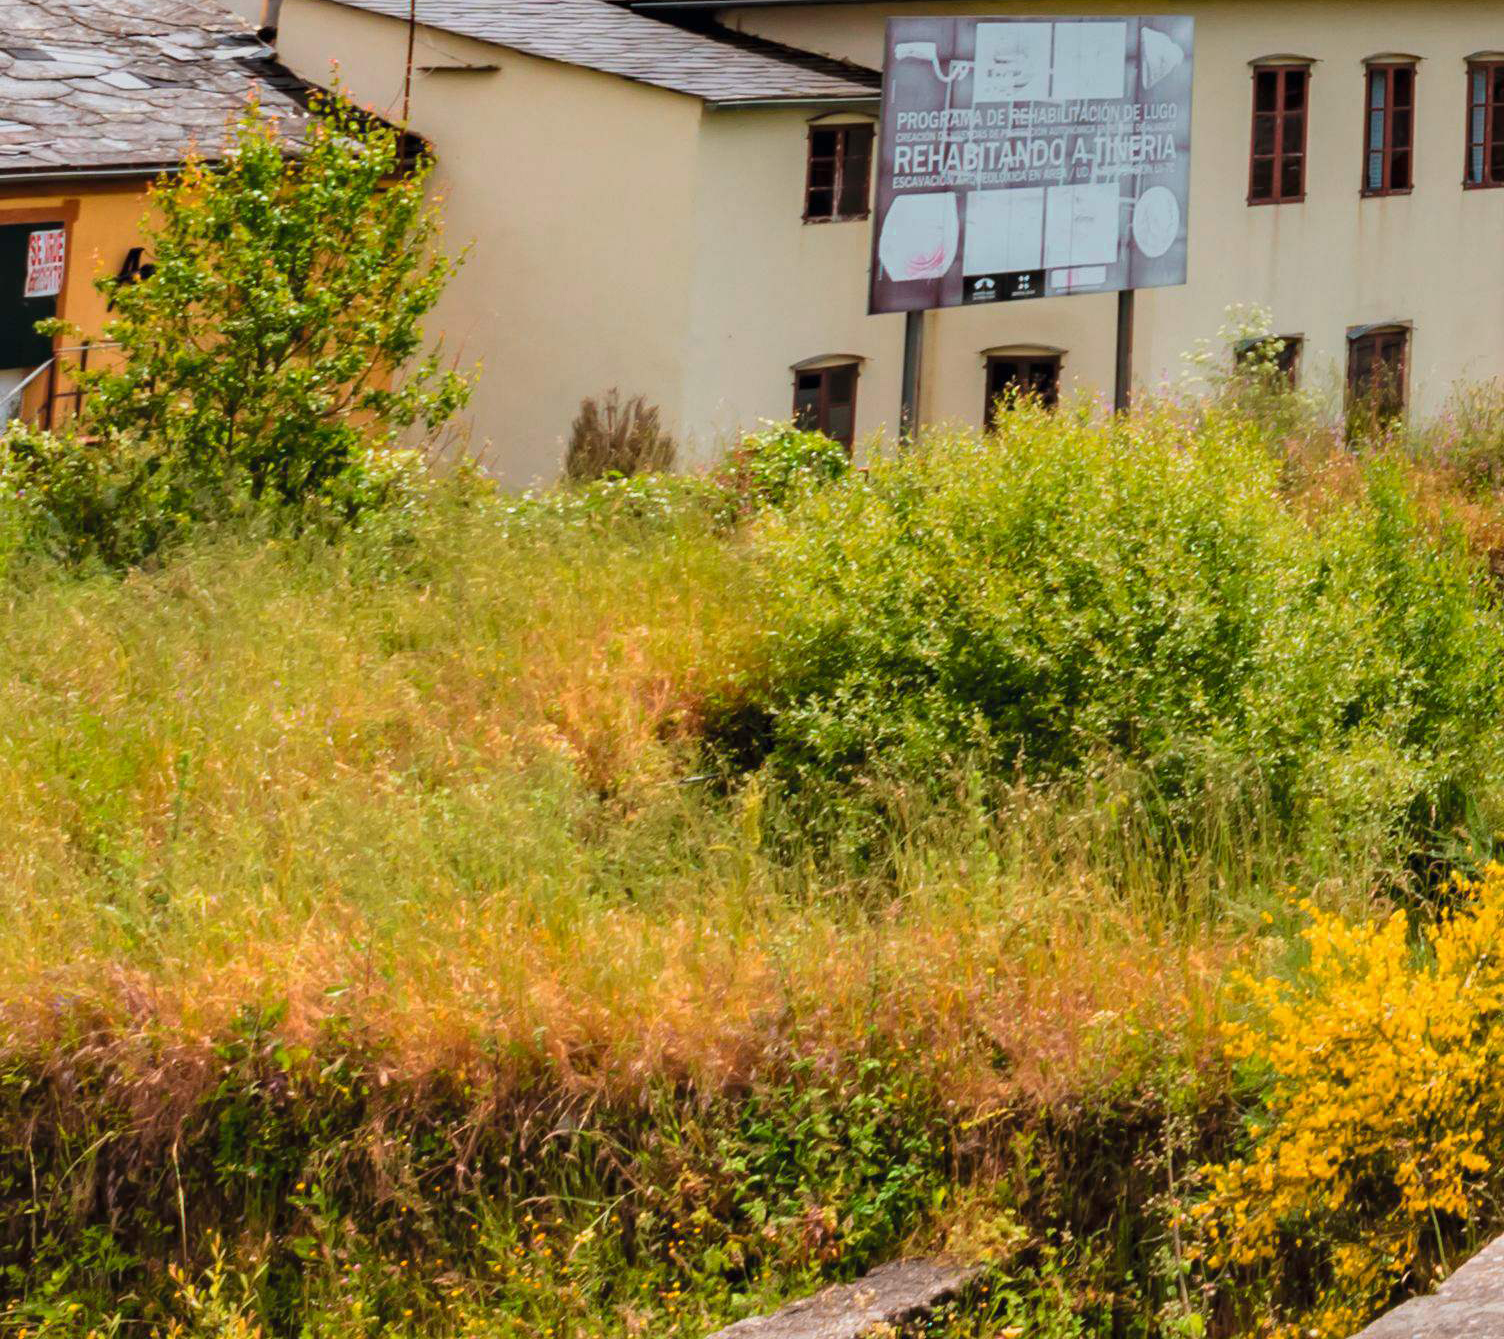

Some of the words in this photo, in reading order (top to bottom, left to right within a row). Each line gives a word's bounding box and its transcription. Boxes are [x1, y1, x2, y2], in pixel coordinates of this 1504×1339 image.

[897, 108, 983, 130] PROGRAMA
[986, 108, 1006, 126] DE
[1010, 102, 1119, 126] REHABILITACIÓN
[1123, 104, 1142, 121] DE
[1144, 103, 1177, 119] LUGO
[894, 138, 1065, 174] REHABITANDO
[1071, 137, 1086, 164] A
[1094, 133, 1177, 163] TINERIA
